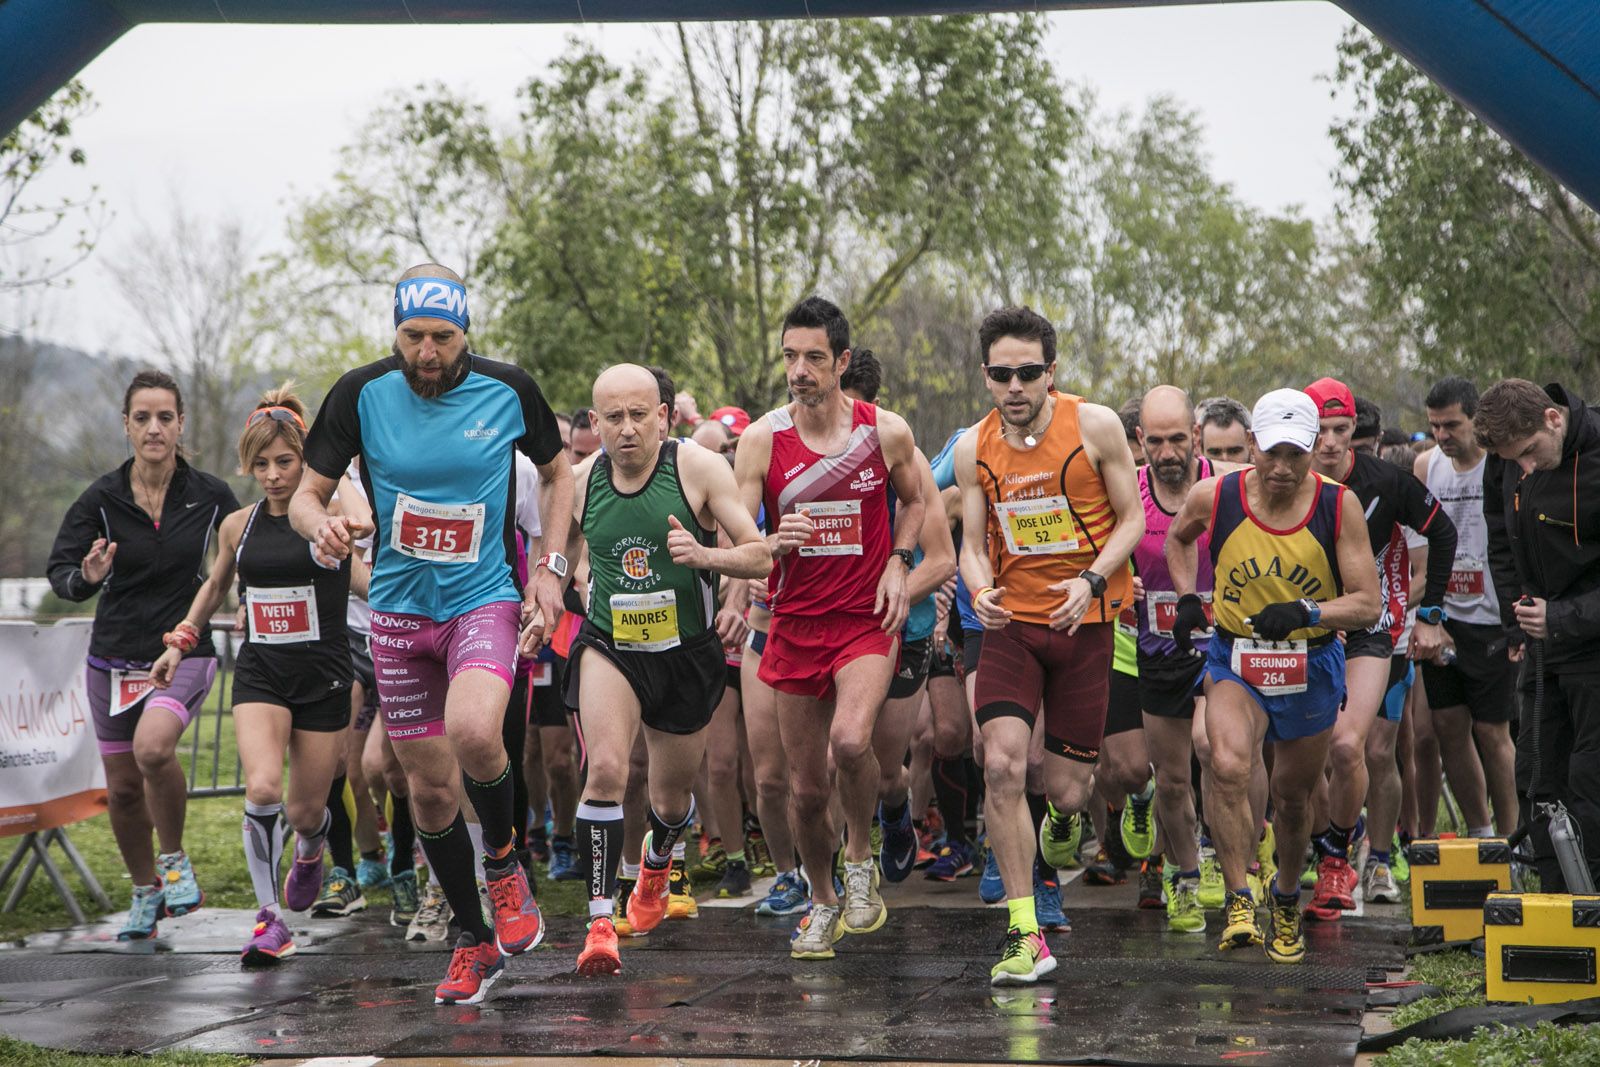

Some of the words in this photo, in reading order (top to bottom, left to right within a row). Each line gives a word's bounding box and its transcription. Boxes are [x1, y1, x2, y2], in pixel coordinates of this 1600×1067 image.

[463, 428, 499, 438] KRONOS
[1004, 471, 1056, 485] Kilometer
[812, 517, 853, 530] LBERTO
[1016, 518, 1038, 531] JOSE
[1040, 514, 1063, 527] LUIS
[413, 526, 457, 552] 315
[819, 531, 842, 544] 144
[1035, 530, 1051, 542] 52
[1222, 556, 1328, 605] ECUADO
[260, 604, 296, 618] YVETH
[1164, 604, 1179, 617] VI
[621, 609, 669, 626] ANDRES
[268, 620, 290, 633] 159
[642, 628, 650, 641] 5
[1249, 657, 1298, 669] SEGUNDO
[1262, 672, 1286, 685] 264
